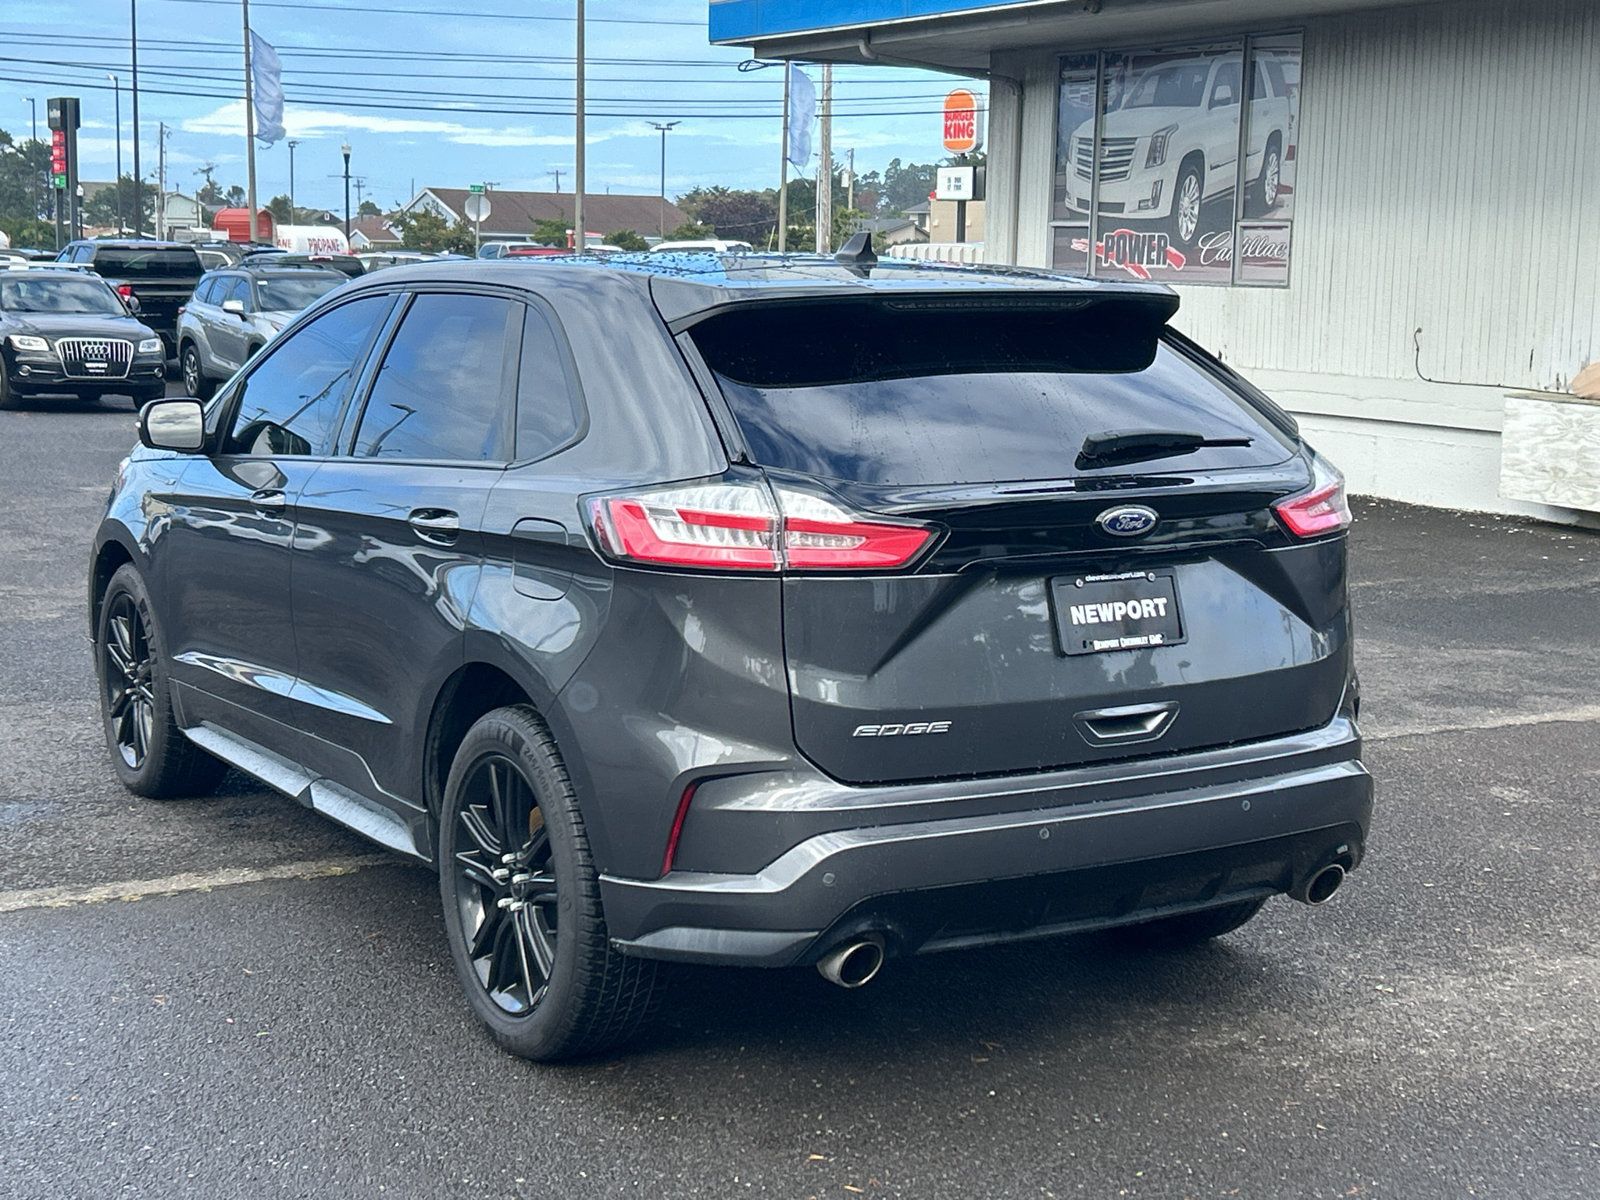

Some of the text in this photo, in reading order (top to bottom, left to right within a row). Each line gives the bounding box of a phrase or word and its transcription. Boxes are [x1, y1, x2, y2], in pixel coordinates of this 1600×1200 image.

[944, 110, 975, 121] BURGER
[944, 121, 975, 139] KING
[307, 238, 340, 252] PROPANE
[1103, 232, 1169, 267] POWER
[1115, 514, 1146, 530] Ford
[1070, 597, 1168, 625] NEWPORT
[852, 721, 953, 737] EDGE
